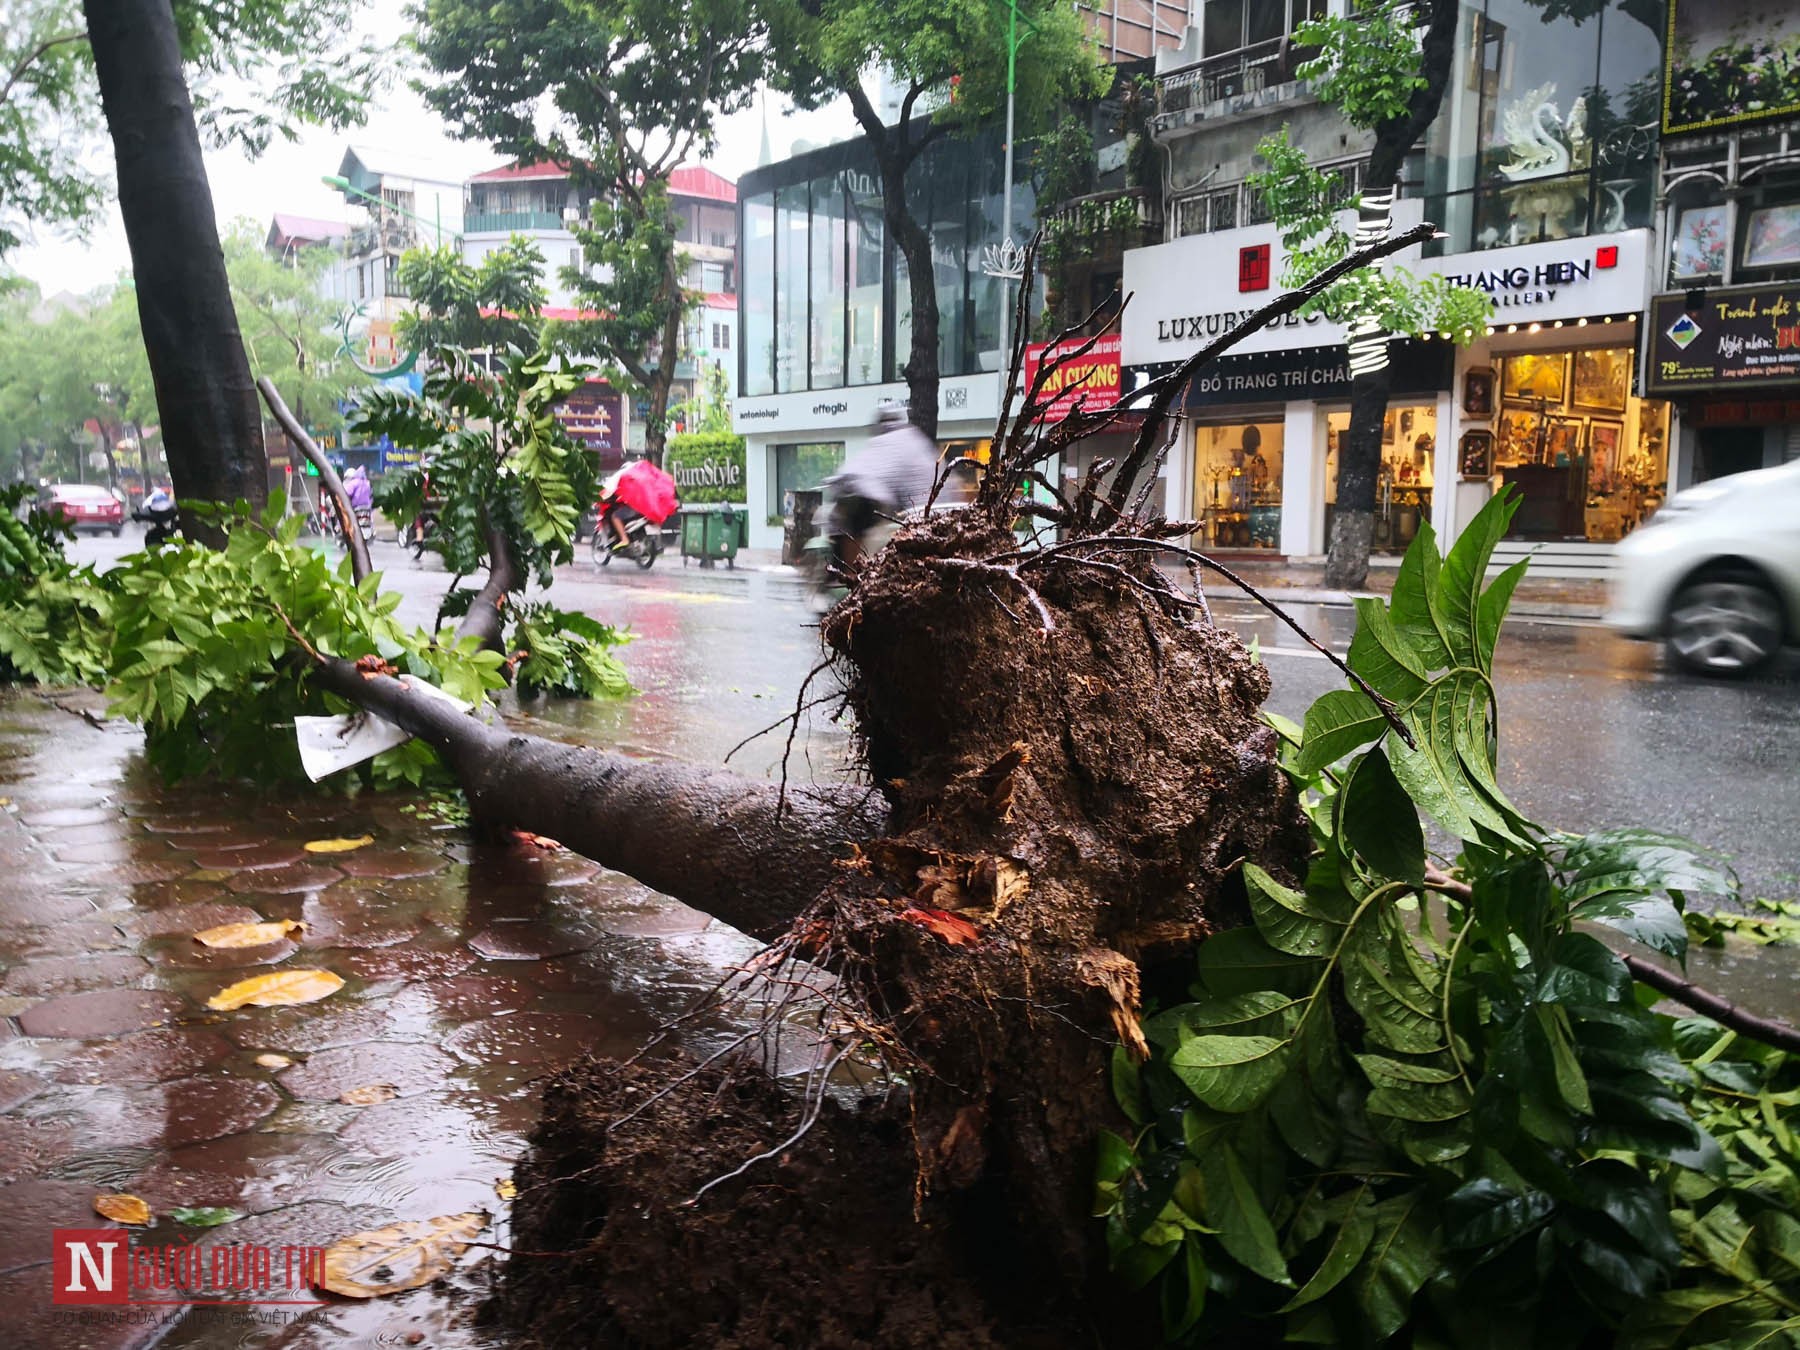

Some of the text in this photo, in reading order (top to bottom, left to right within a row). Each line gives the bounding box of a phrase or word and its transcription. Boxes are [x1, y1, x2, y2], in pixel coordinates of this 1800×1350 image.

[1480, 290, 1556, 308] ALLERY
[1226, 373, 1278, 391] TRANG
[1282, 366, 1308, 386] TRÍ
[672, 457, 740, 491] EuroStyle
